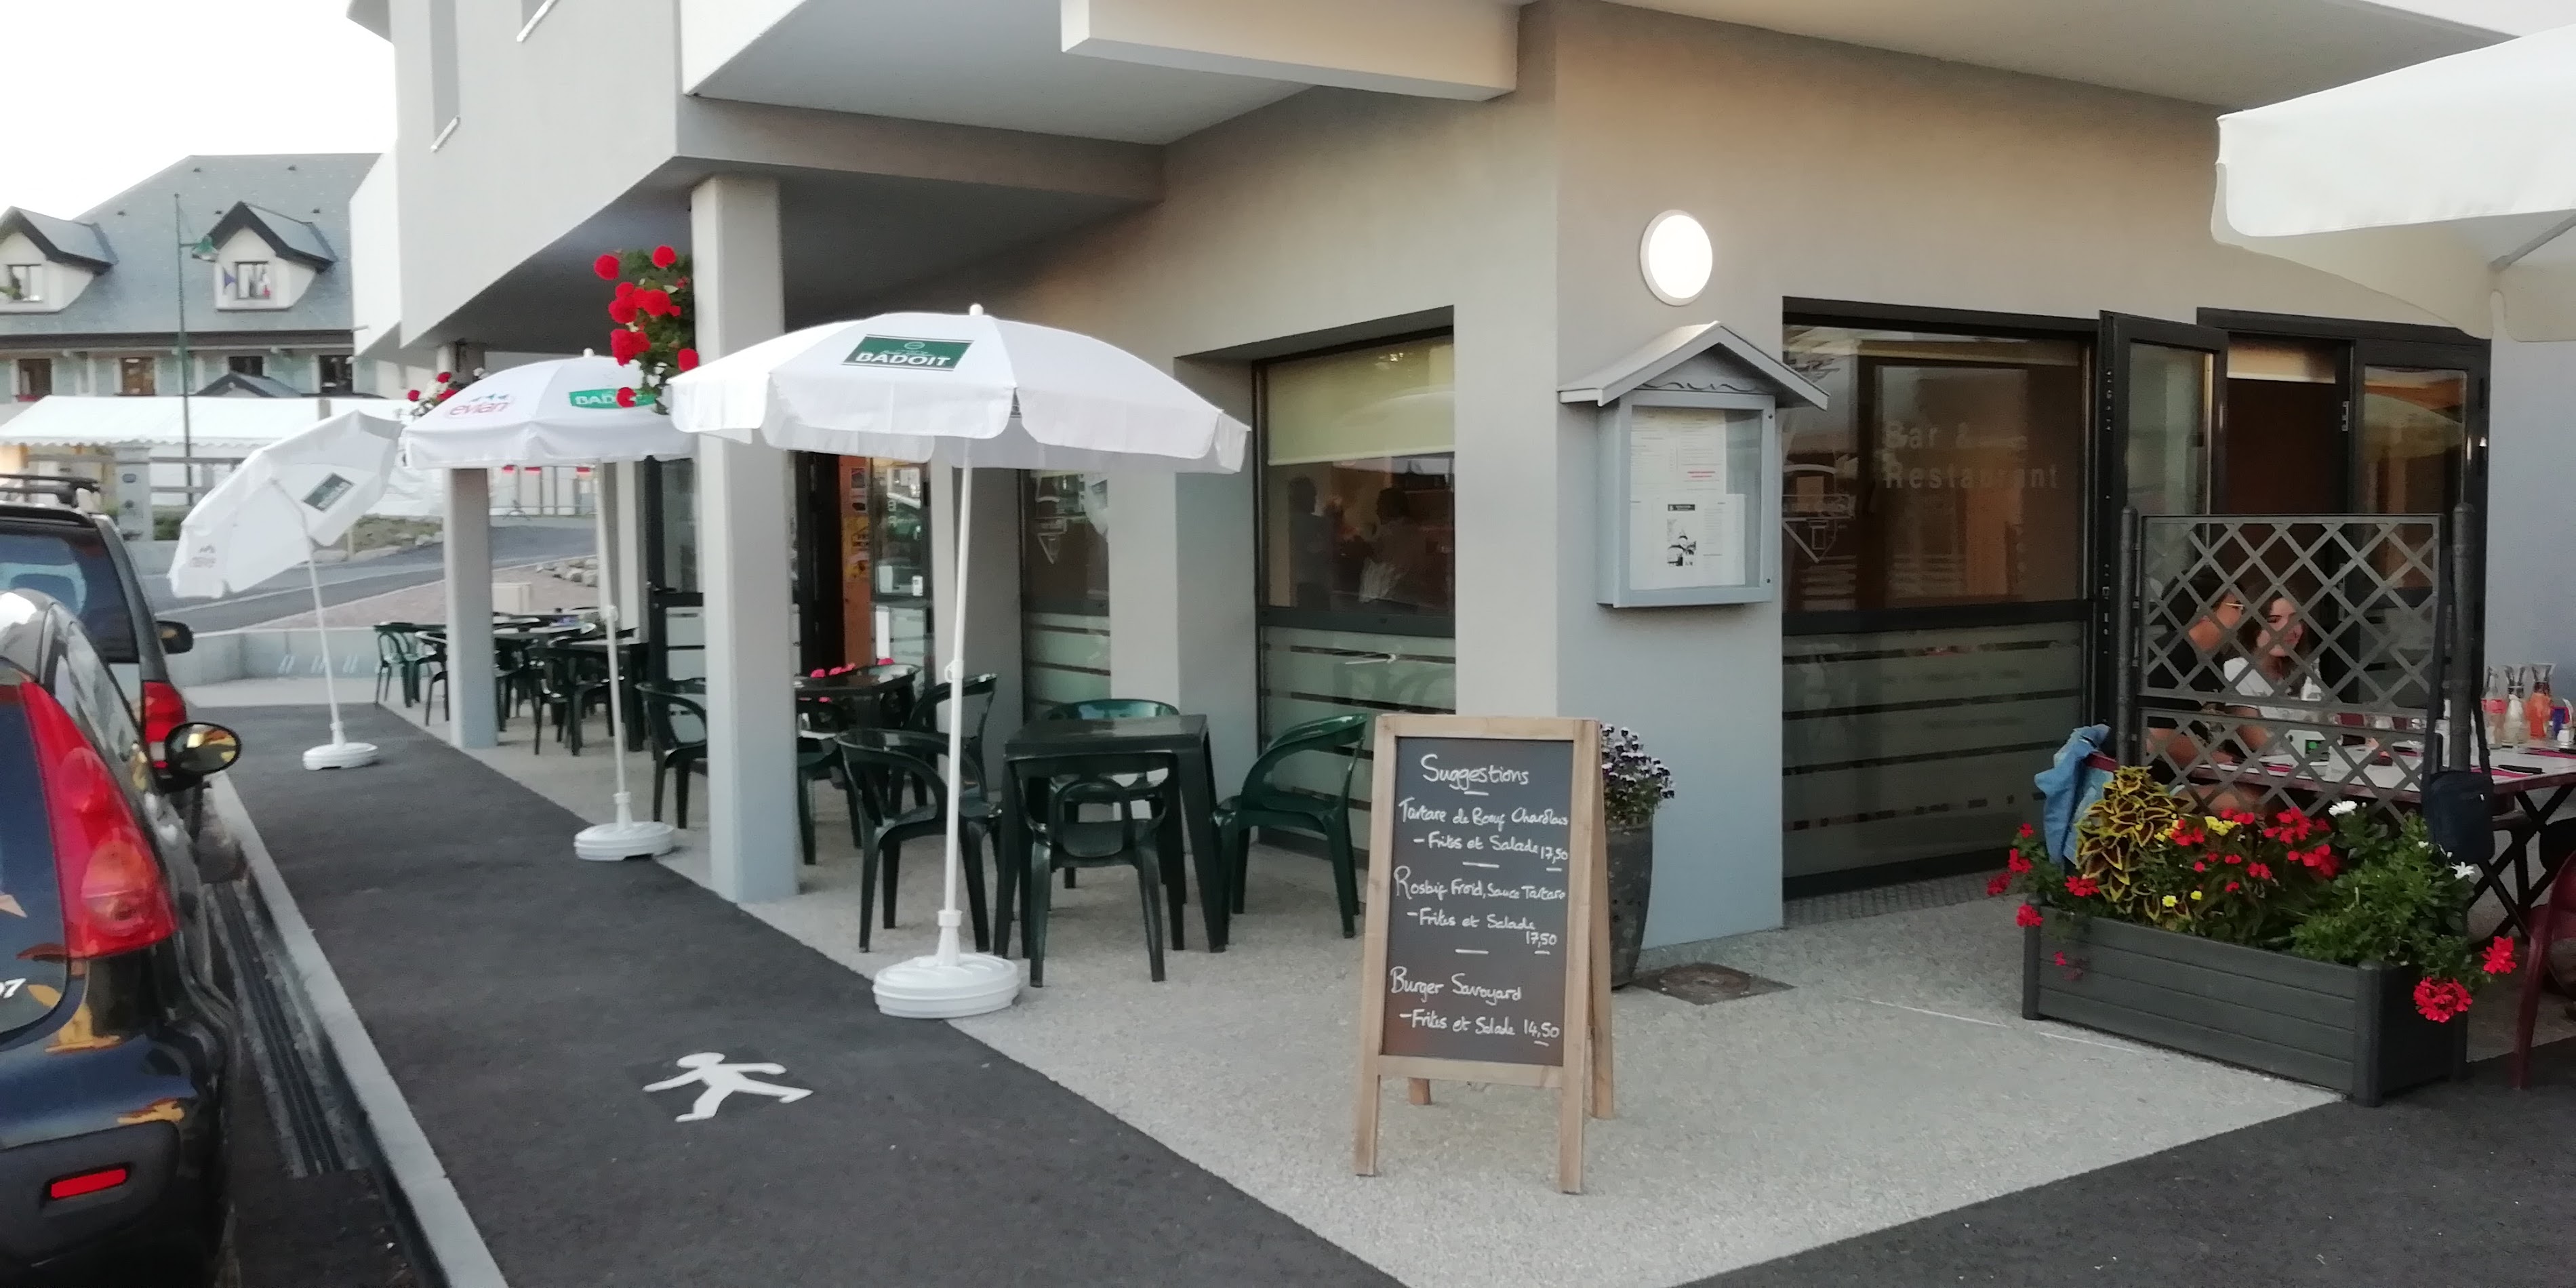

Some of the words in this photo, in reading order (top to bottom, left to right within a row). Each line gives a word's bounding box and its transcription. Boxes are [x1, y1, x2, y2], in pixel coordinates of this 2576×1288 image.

[856, 351, 950, 366] BADOIT
[449, 401, 509, 416] evian
[1884, 421, 1940, 449] Bar
[1420, 753, 1529, 790] Suggestions
[1398, 797, 1447, 822] Tartare
[1452, 808, 1470, 824] de
[1467, 837, 1484, 850] et
[1489, 835, 1539, 854] Salade
[1540, 846, 1569, 864] 17,50
[1394, 865, 1448, 901] Rosbif
[1487, 882, 1520, 900] Sauce
[1462, 914, 1481, 928] et
[1486, 913, 1536, 931] Salade
[1525, 931, 1558, 948] 17,50
[1390, 965, 1445, 1003] Burger
[1451, 972, 1522, 1006] Savoyard
[1452, 1015, 1471, 1032] et
[1475, 1016, 1516, 1036] Salade
[1523, 1019, 1561, 1039] 14,50
